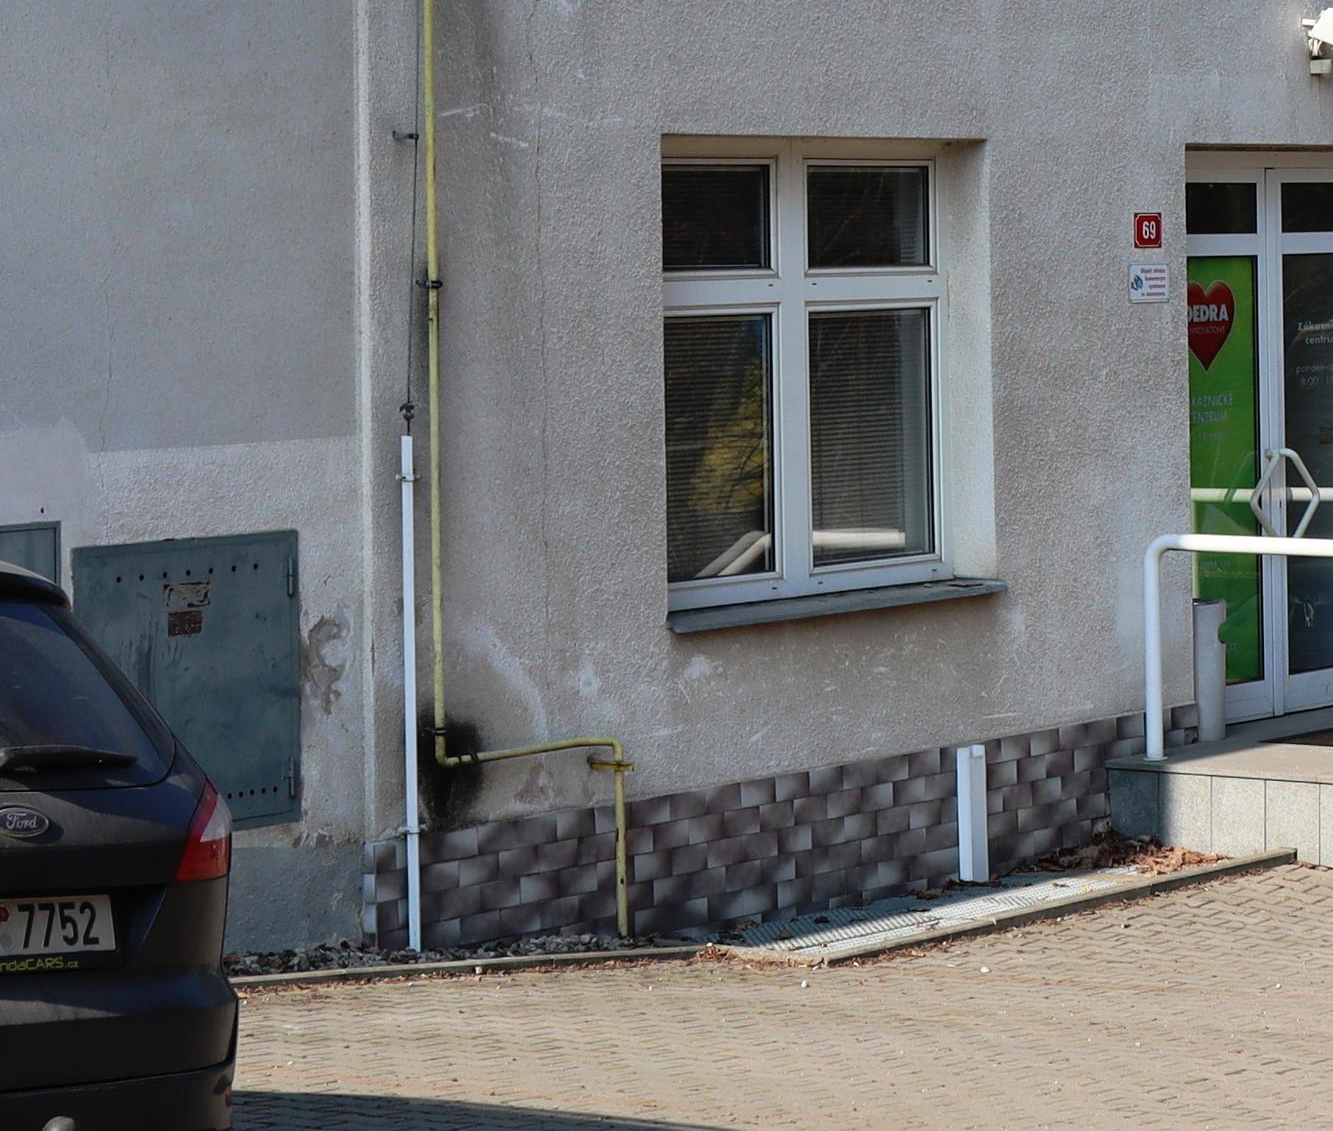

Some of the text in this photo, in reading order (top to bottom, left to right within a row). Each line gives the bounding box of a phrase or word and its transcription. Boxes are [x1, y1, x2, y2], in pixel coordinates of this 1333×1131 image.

[1142, 220, 1156, 240] 69
[6, 812, 38, 830] Ford
[17, 901, 100, 949] 7752
